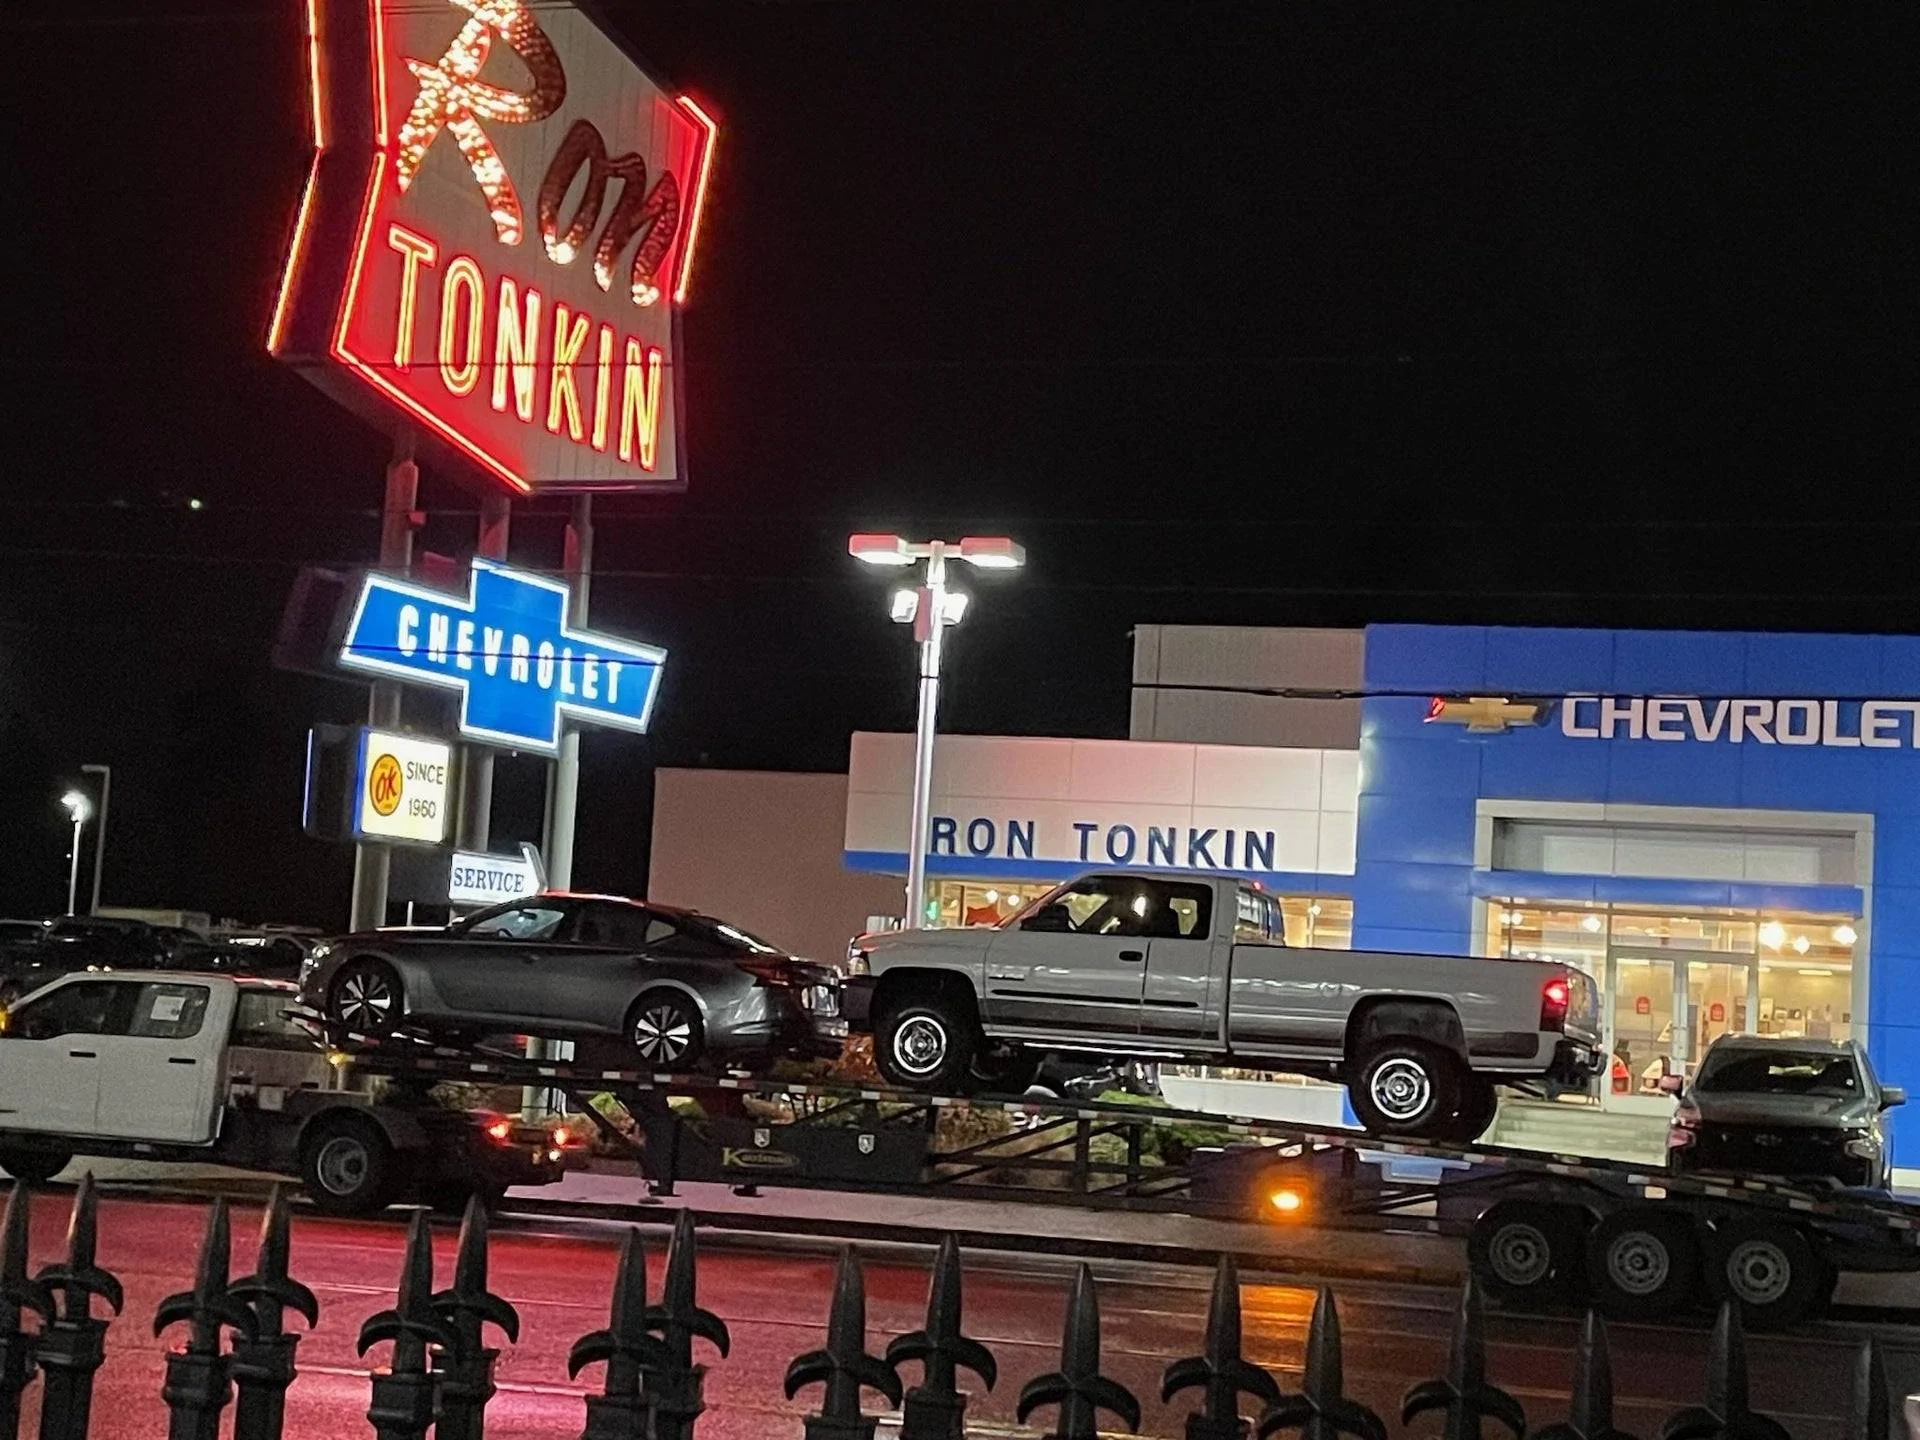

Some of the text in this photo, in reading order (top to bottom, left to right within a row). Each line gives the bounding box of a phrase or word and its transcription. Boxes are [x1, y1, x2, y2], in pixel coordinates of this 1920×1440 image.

[396, 0, 681, 306] Ron
[388, 222, 663, 472] TONKIN
[397, 604, 623, 704] CHEVROLET
[375, 765, 398, 805] OK
[406, 760, 445, 785] SINCE
[408, 797, 437, 819] 1960
[931, 816, 1276, 871] RON TONKIN
[453, 867, 525, 893] SERVICE
